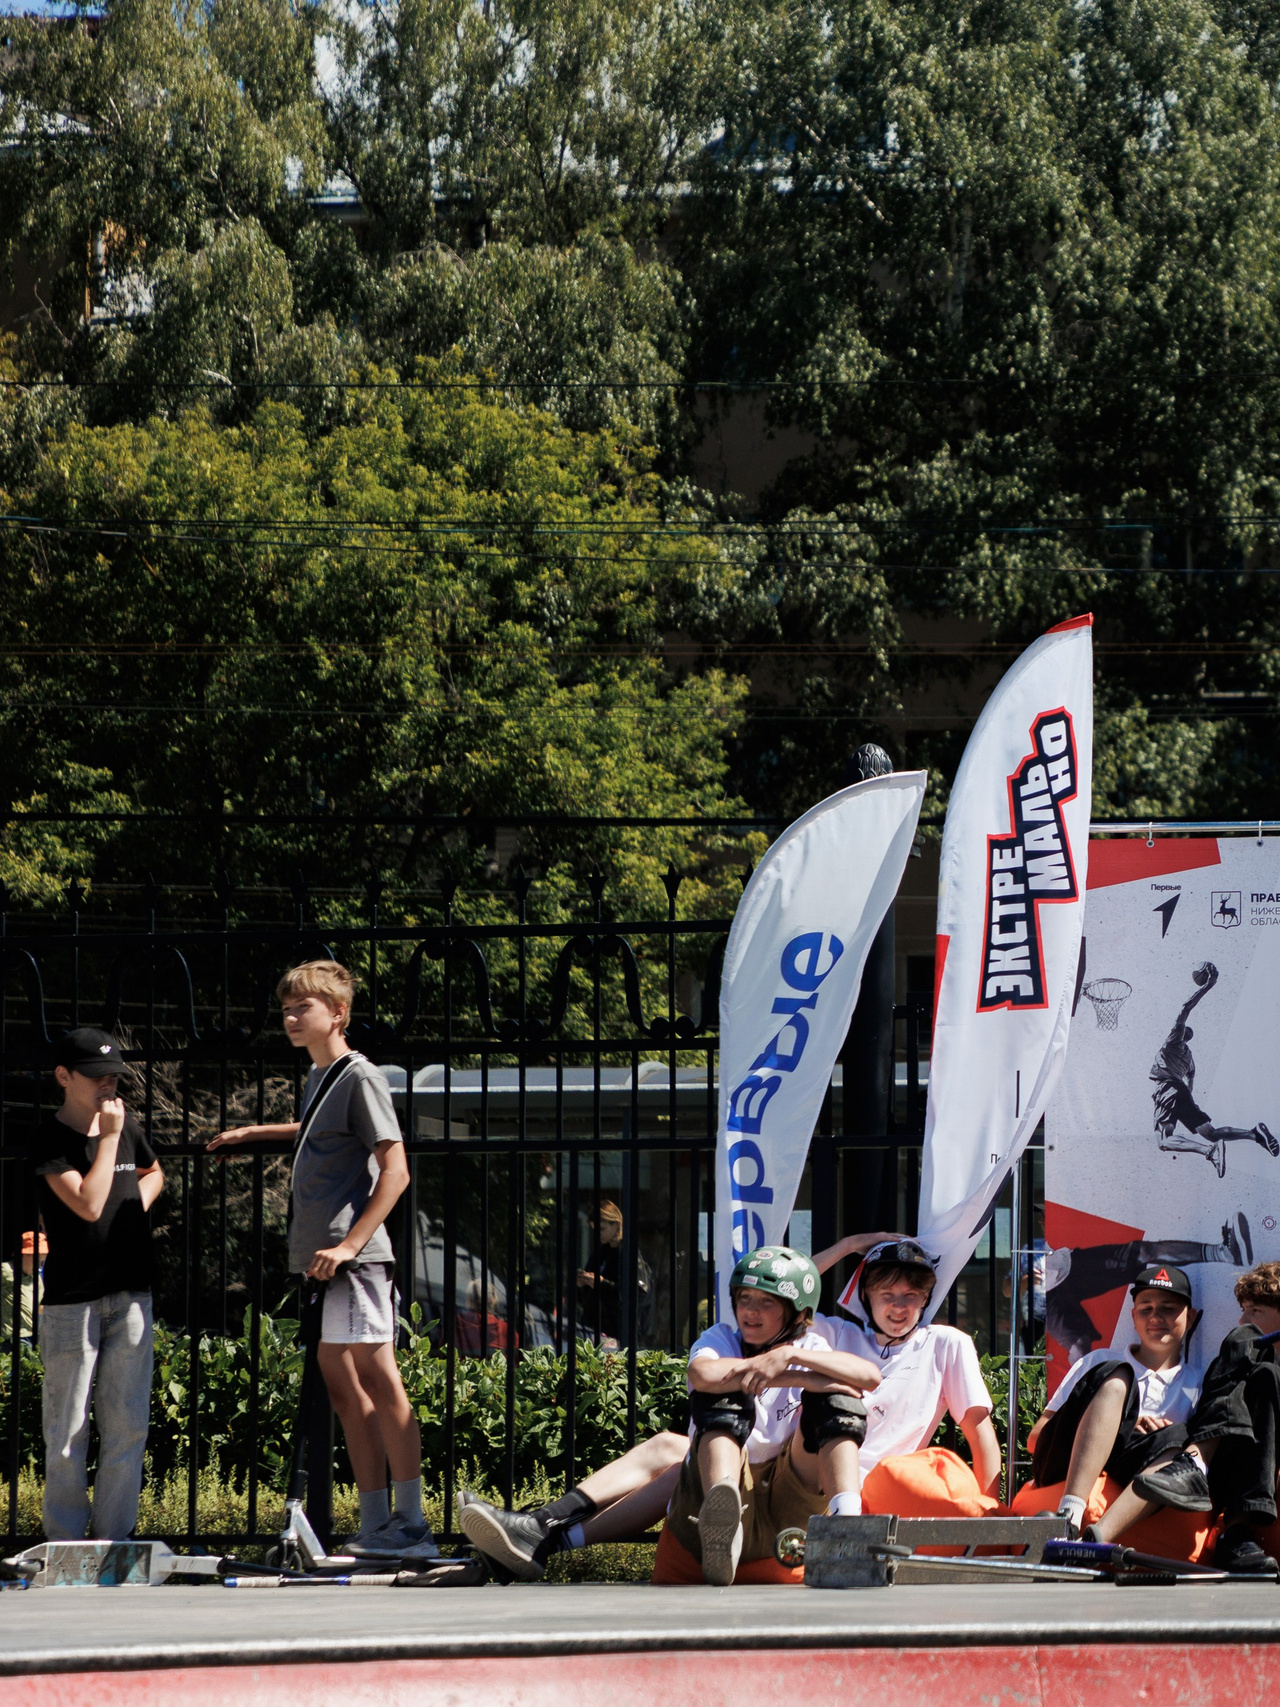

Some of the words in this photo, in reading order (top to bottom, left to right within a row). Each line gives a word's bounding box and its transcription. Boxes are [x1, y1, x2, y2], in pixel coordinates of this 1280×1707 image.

[1039, 719, 1071, 796] НО
[1020, 763, 1070, 891] МАЛЬ
[1150, 883, 1182, 892] Первые
[985, 845, 1034, 999] ЭКСТРЕ
[715, 932, 844, 1324] ервые
